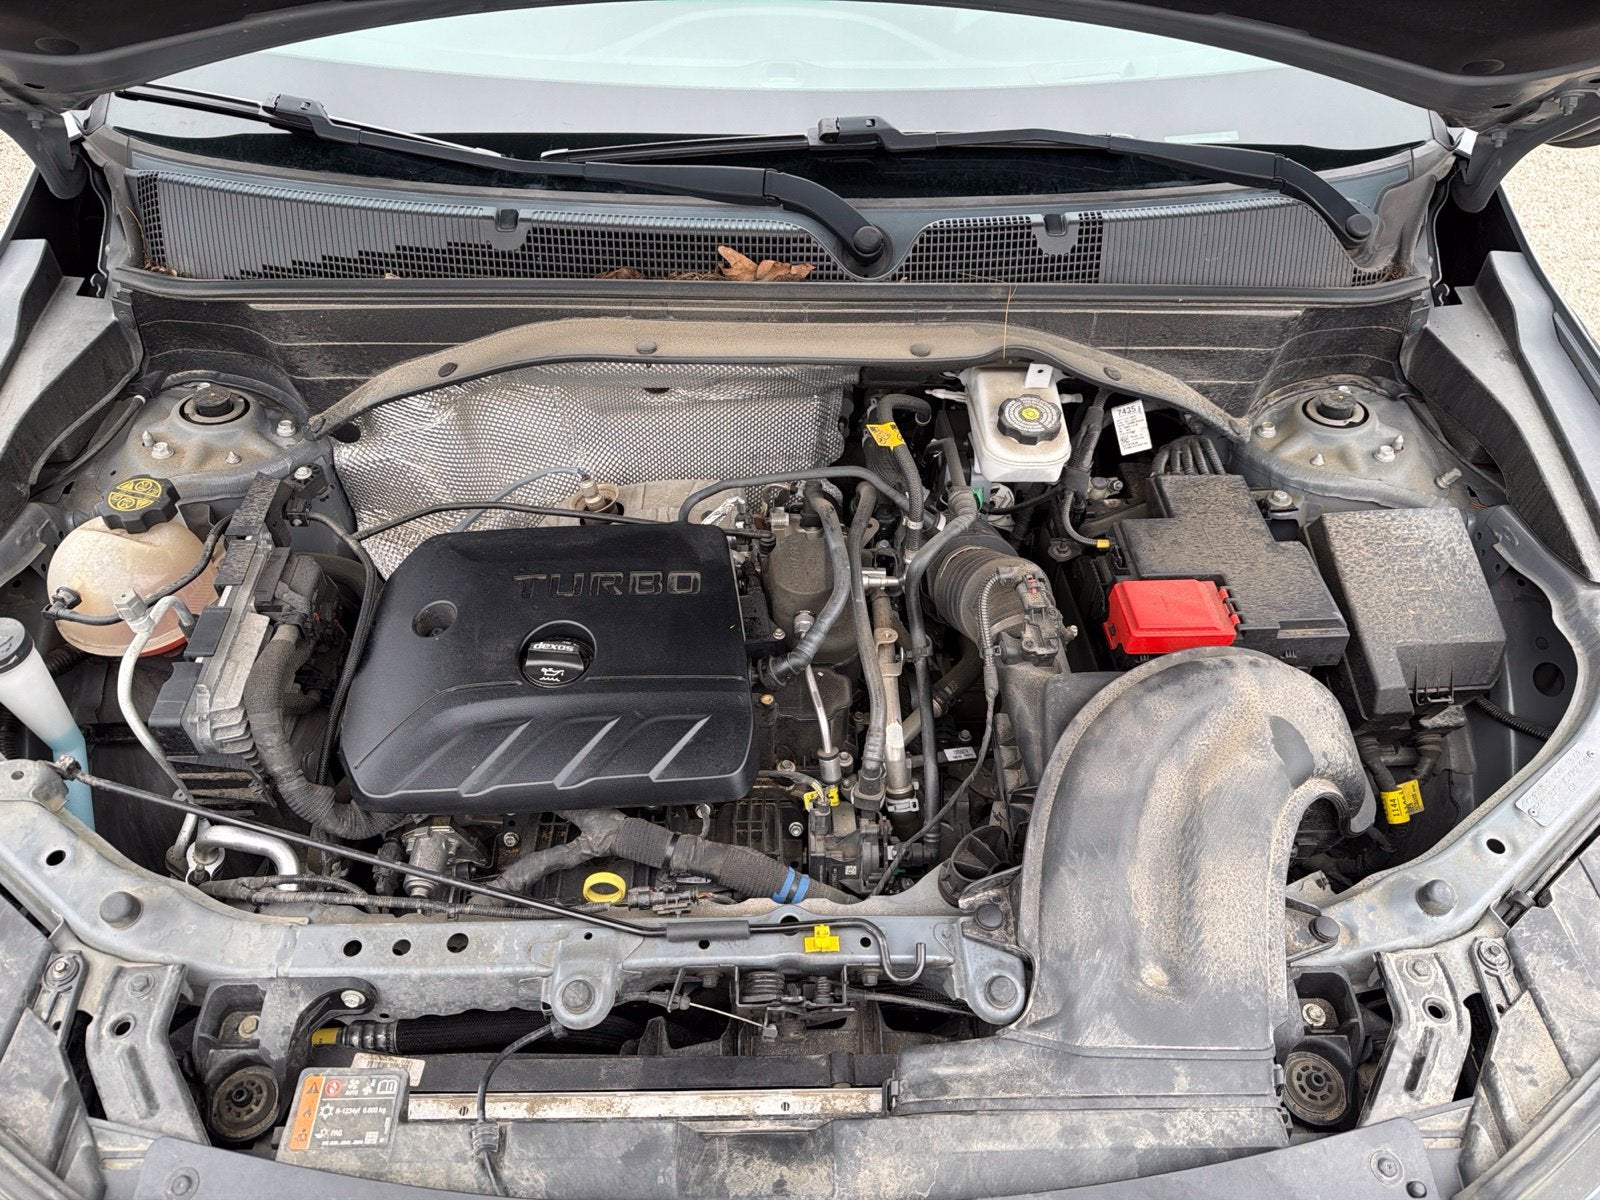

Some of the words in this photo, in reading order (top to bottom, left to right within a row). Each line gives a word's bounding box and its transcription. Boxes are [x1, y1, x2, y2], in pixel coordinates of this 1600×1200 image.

[1117, 405, 1136, 416] 7435
[514, 571, 701, 599] TURBO
[533, 642, 574, 652] dexos
